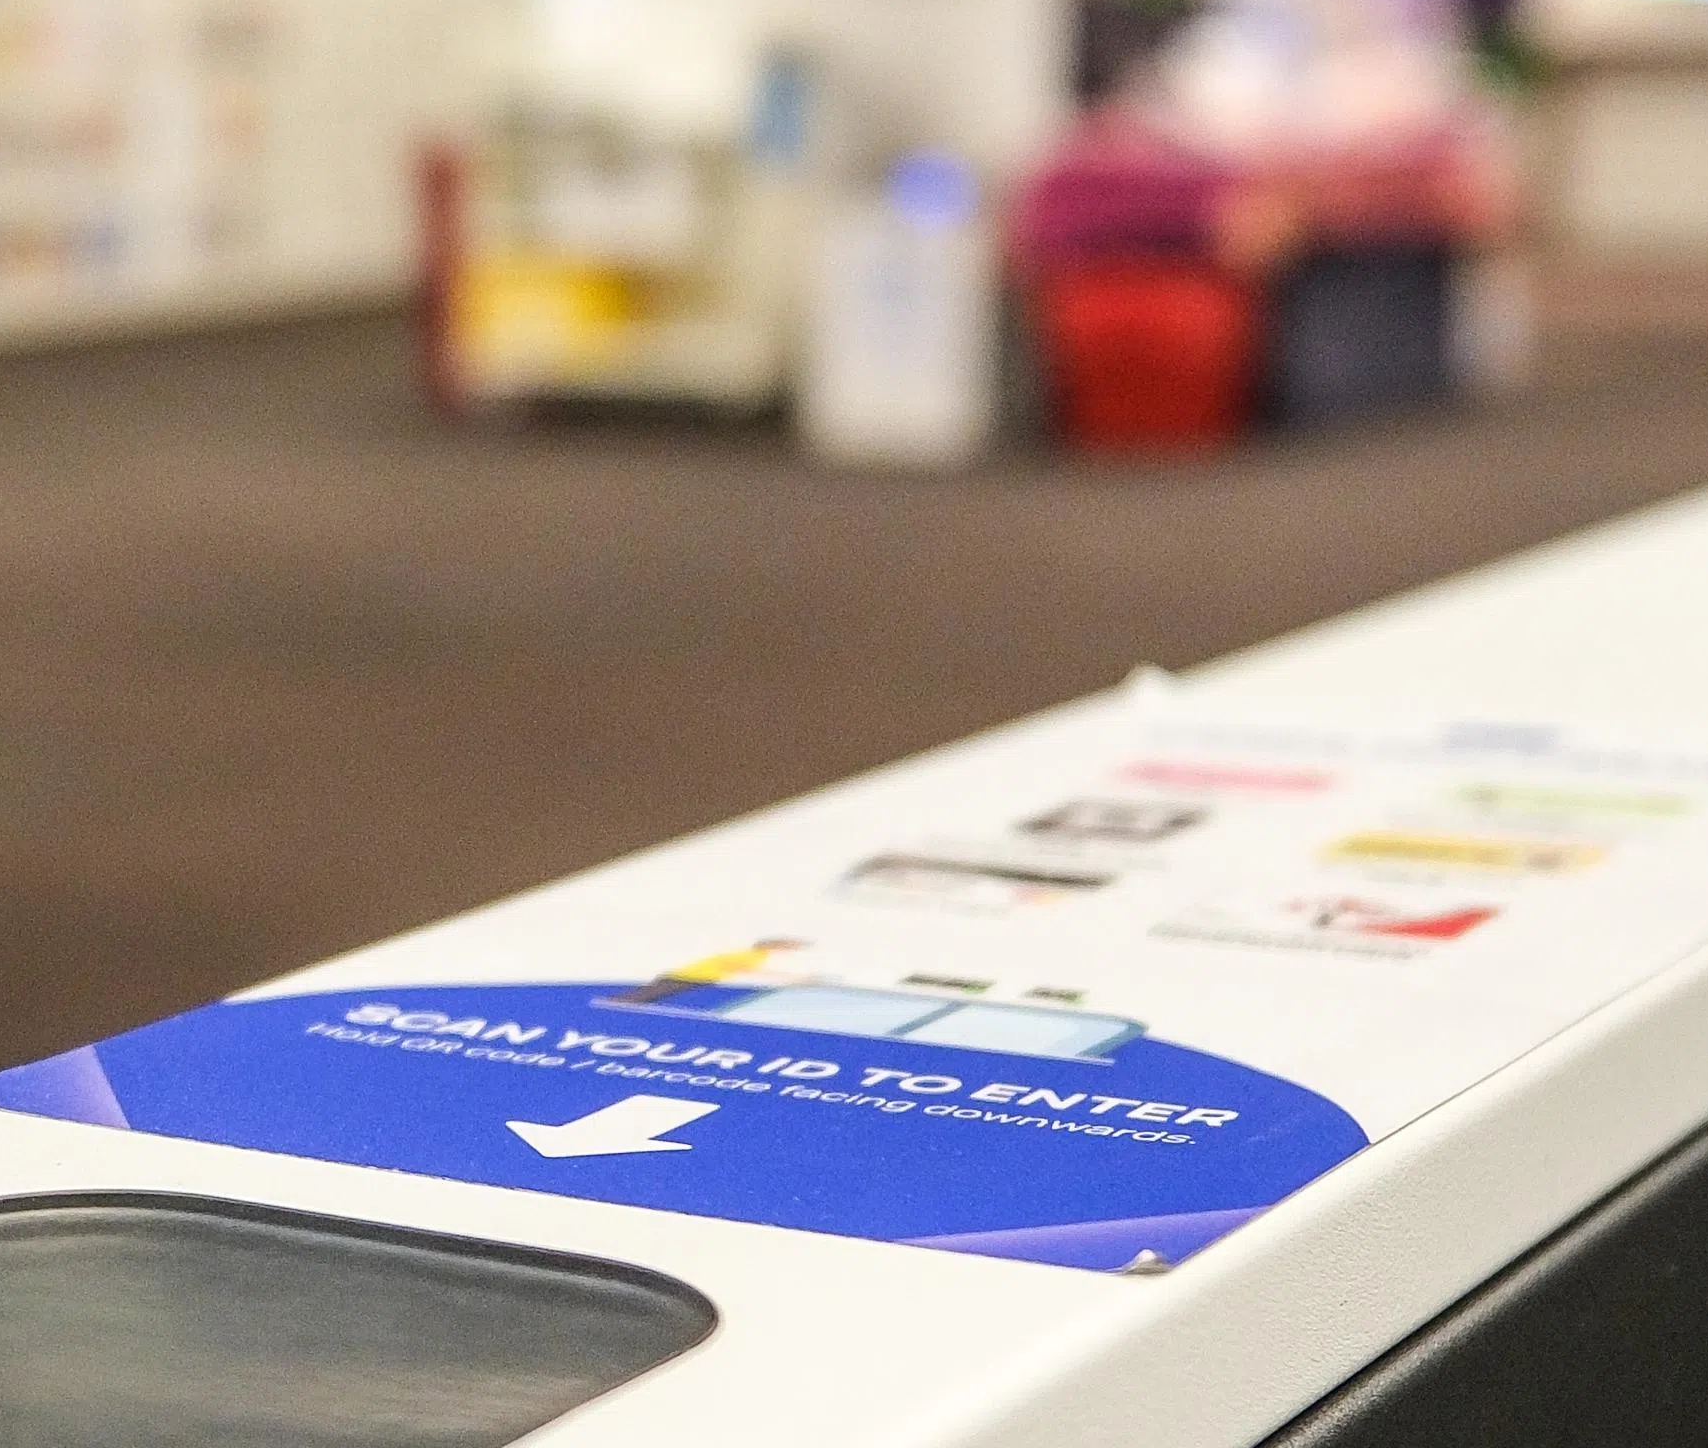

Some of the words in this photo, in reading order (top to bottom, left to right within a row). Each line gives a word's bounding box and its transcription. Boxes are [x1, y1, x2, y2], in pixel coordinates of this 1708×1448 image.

[304, 1021, 402, 1048] Hold
[401, 1036, 464, 1055] QR
[464, 1044, 567, 1068] code
[595, 1059, 772, 1094] barcode
[779, 1084, 917, 1114] facing
[923, 1103, 1197, 1146] downwards.
[346, 1002, 546, 1045] SCAN
[559, 1029, 754, 1071] YOUR
[758, 1057, 839, 1080] ID
[863, 1067, 963, 1095] TO
[970, 1082, 1241, 1128] ENTER
